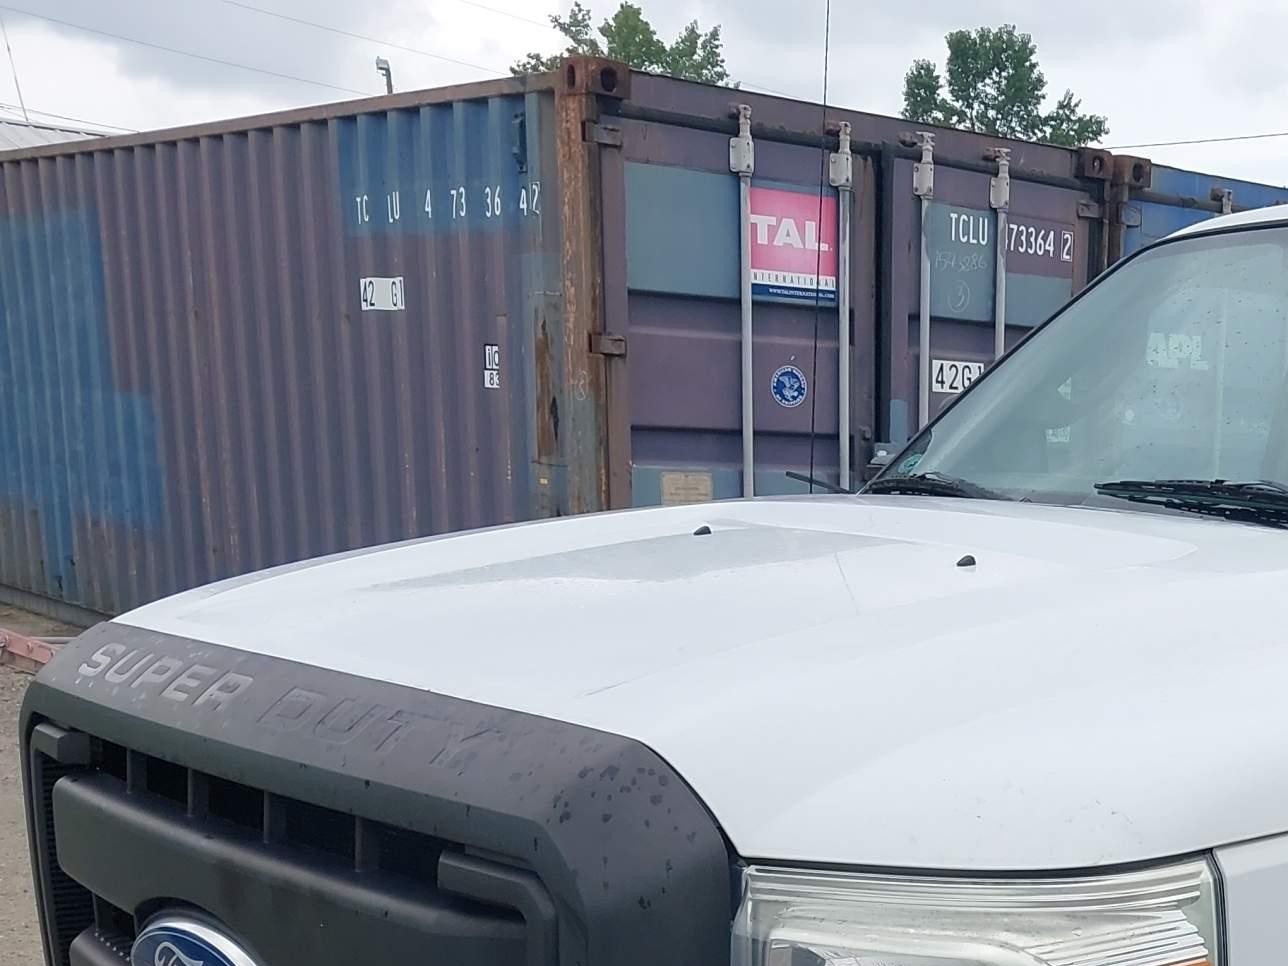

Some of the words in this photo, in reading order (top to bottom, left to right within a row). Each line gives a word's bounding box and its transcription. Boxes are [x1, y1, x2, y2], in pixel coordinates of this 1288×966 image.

[750, 214, 829, 252] TAL
[950, 213, 988, 246] TCLU
[1006, 223, 1055, 257] 73364
[78, 642, 255, 711] SUPER
[256, 686, 504, 769] DUTY
